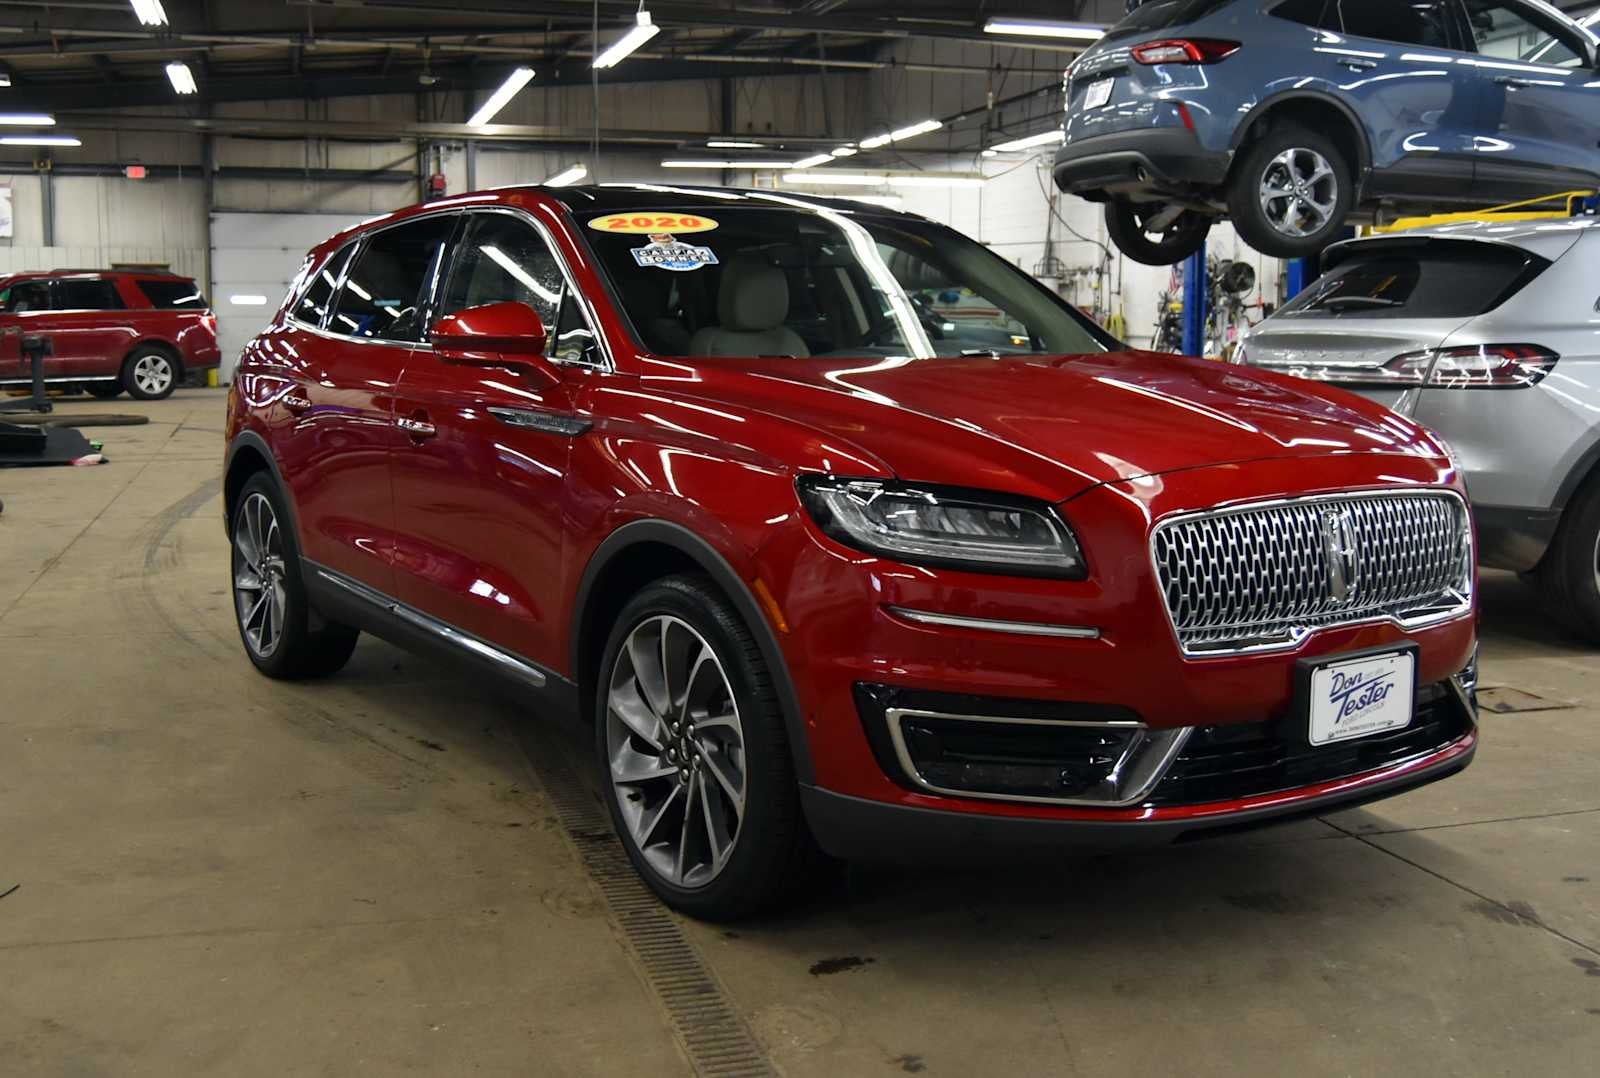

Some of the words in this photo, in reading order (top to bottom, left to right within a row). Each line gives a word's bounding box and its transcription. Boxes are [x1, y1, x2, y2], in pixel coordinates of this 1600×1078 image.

[607, 217, 702, 229] 2020
[1329, 672, 1363, 698] Don
[1330, 671, 1395, 725] Tester
